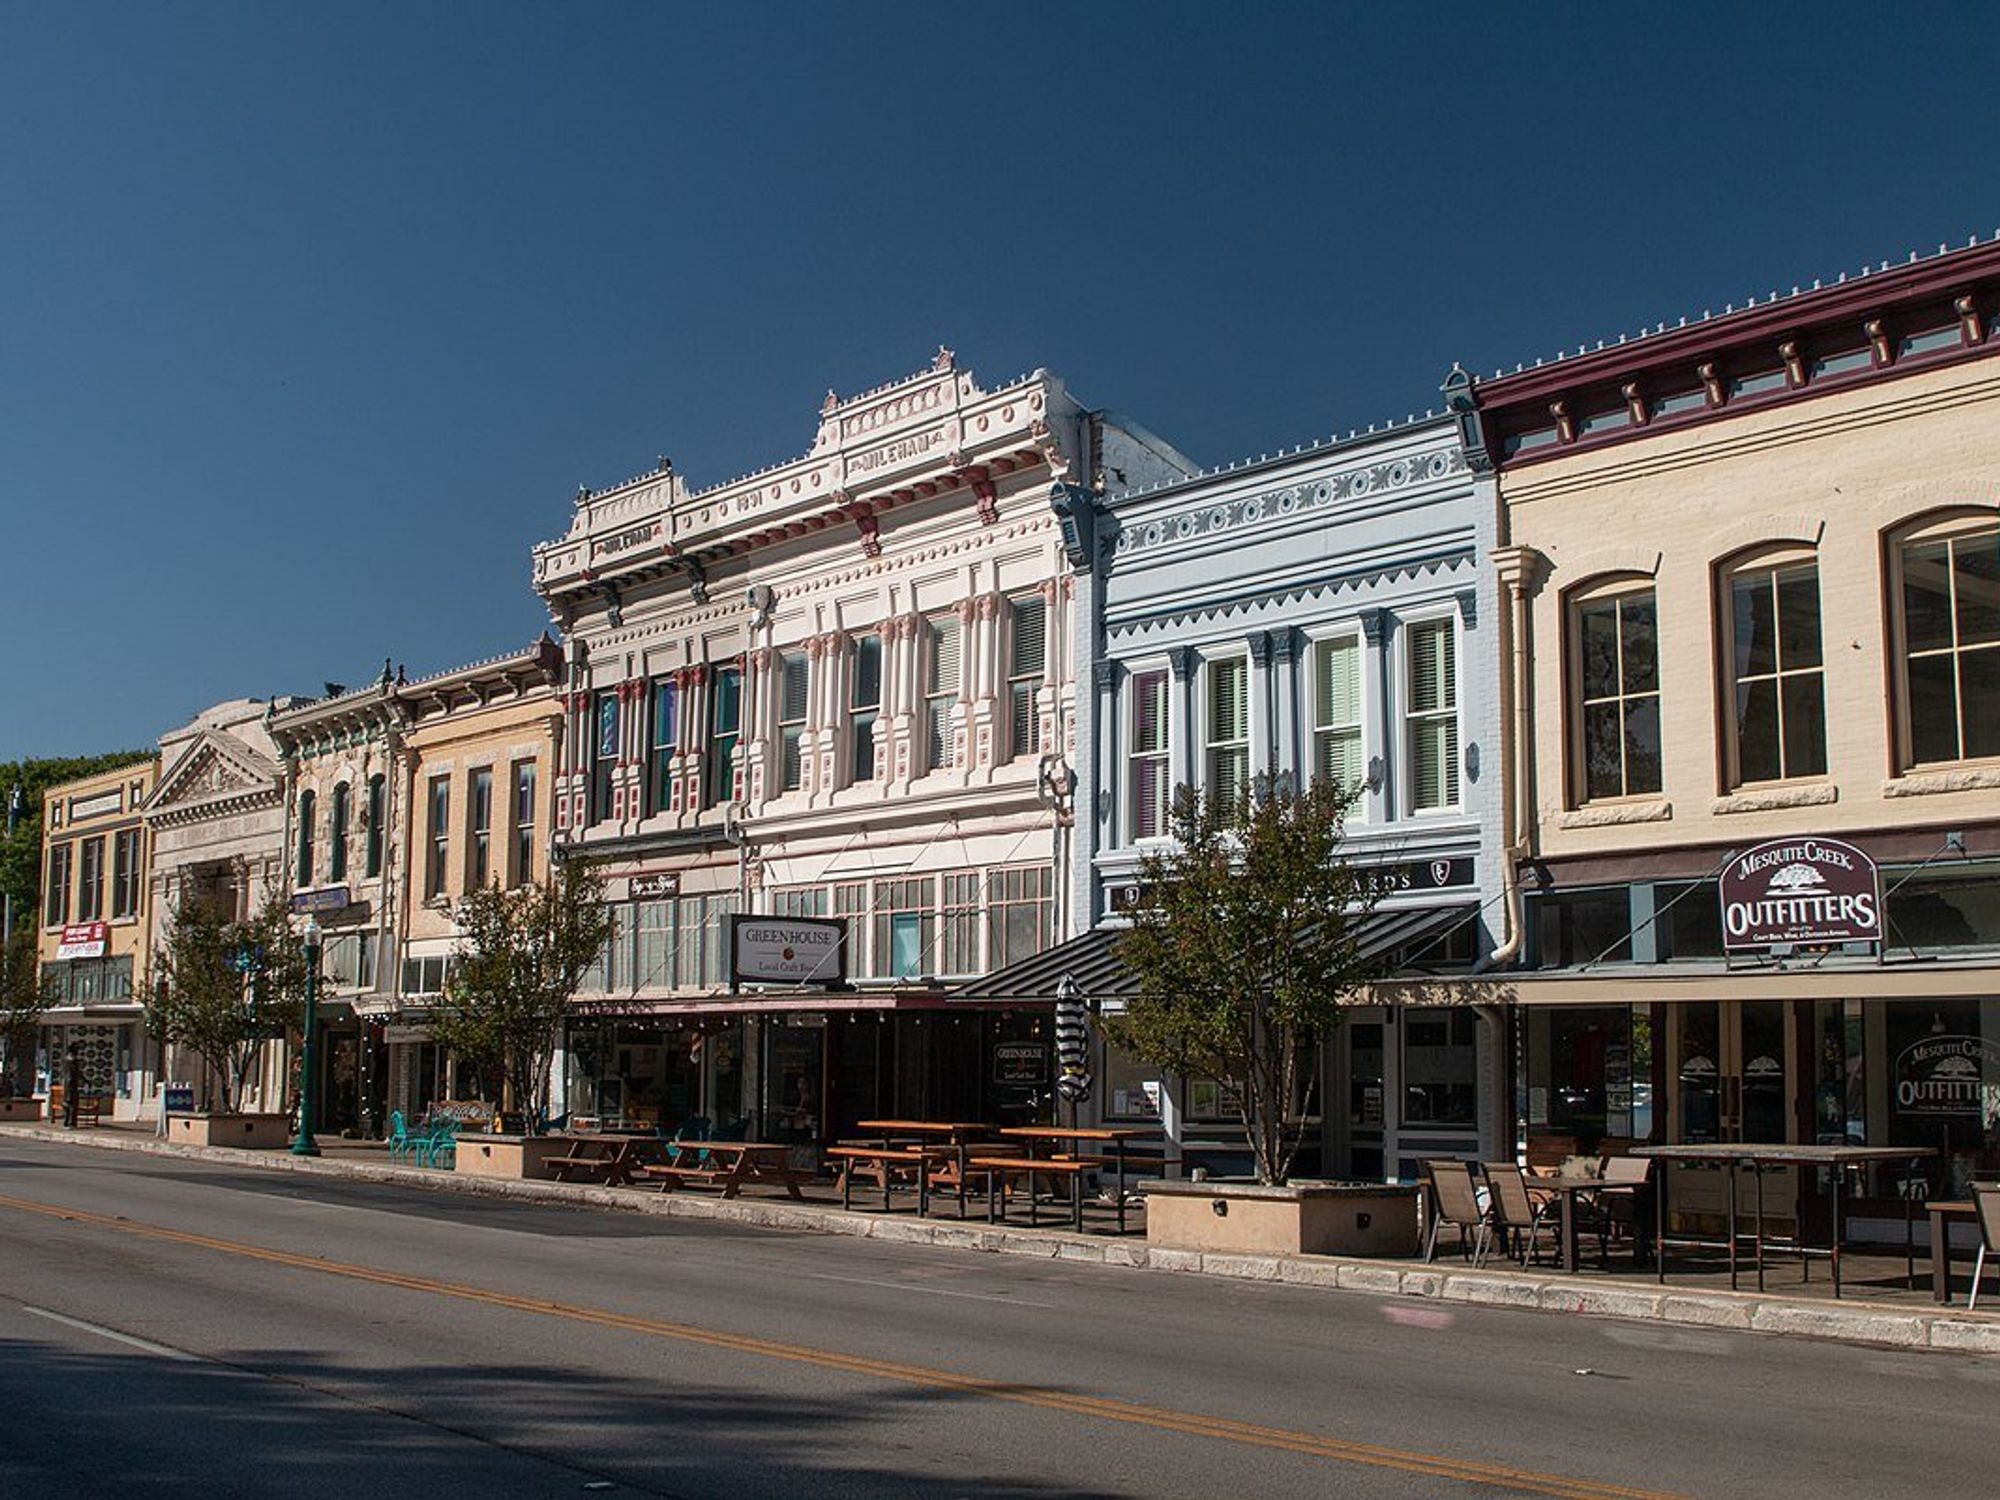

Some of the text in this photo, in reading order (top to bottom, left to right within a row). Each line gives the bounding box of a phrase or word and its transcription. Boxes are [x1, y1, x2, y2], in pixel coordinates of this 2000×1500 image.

[862, 434, 930, 472] MILEHAM
[1738, 841, 1854, 880] MESQUITE CREEK
[1726, 893, 1876, 936] OUTFITTERS
[745, 927, 833, 946] GREENHOUSE
[758, 961, 778, 972] Local
